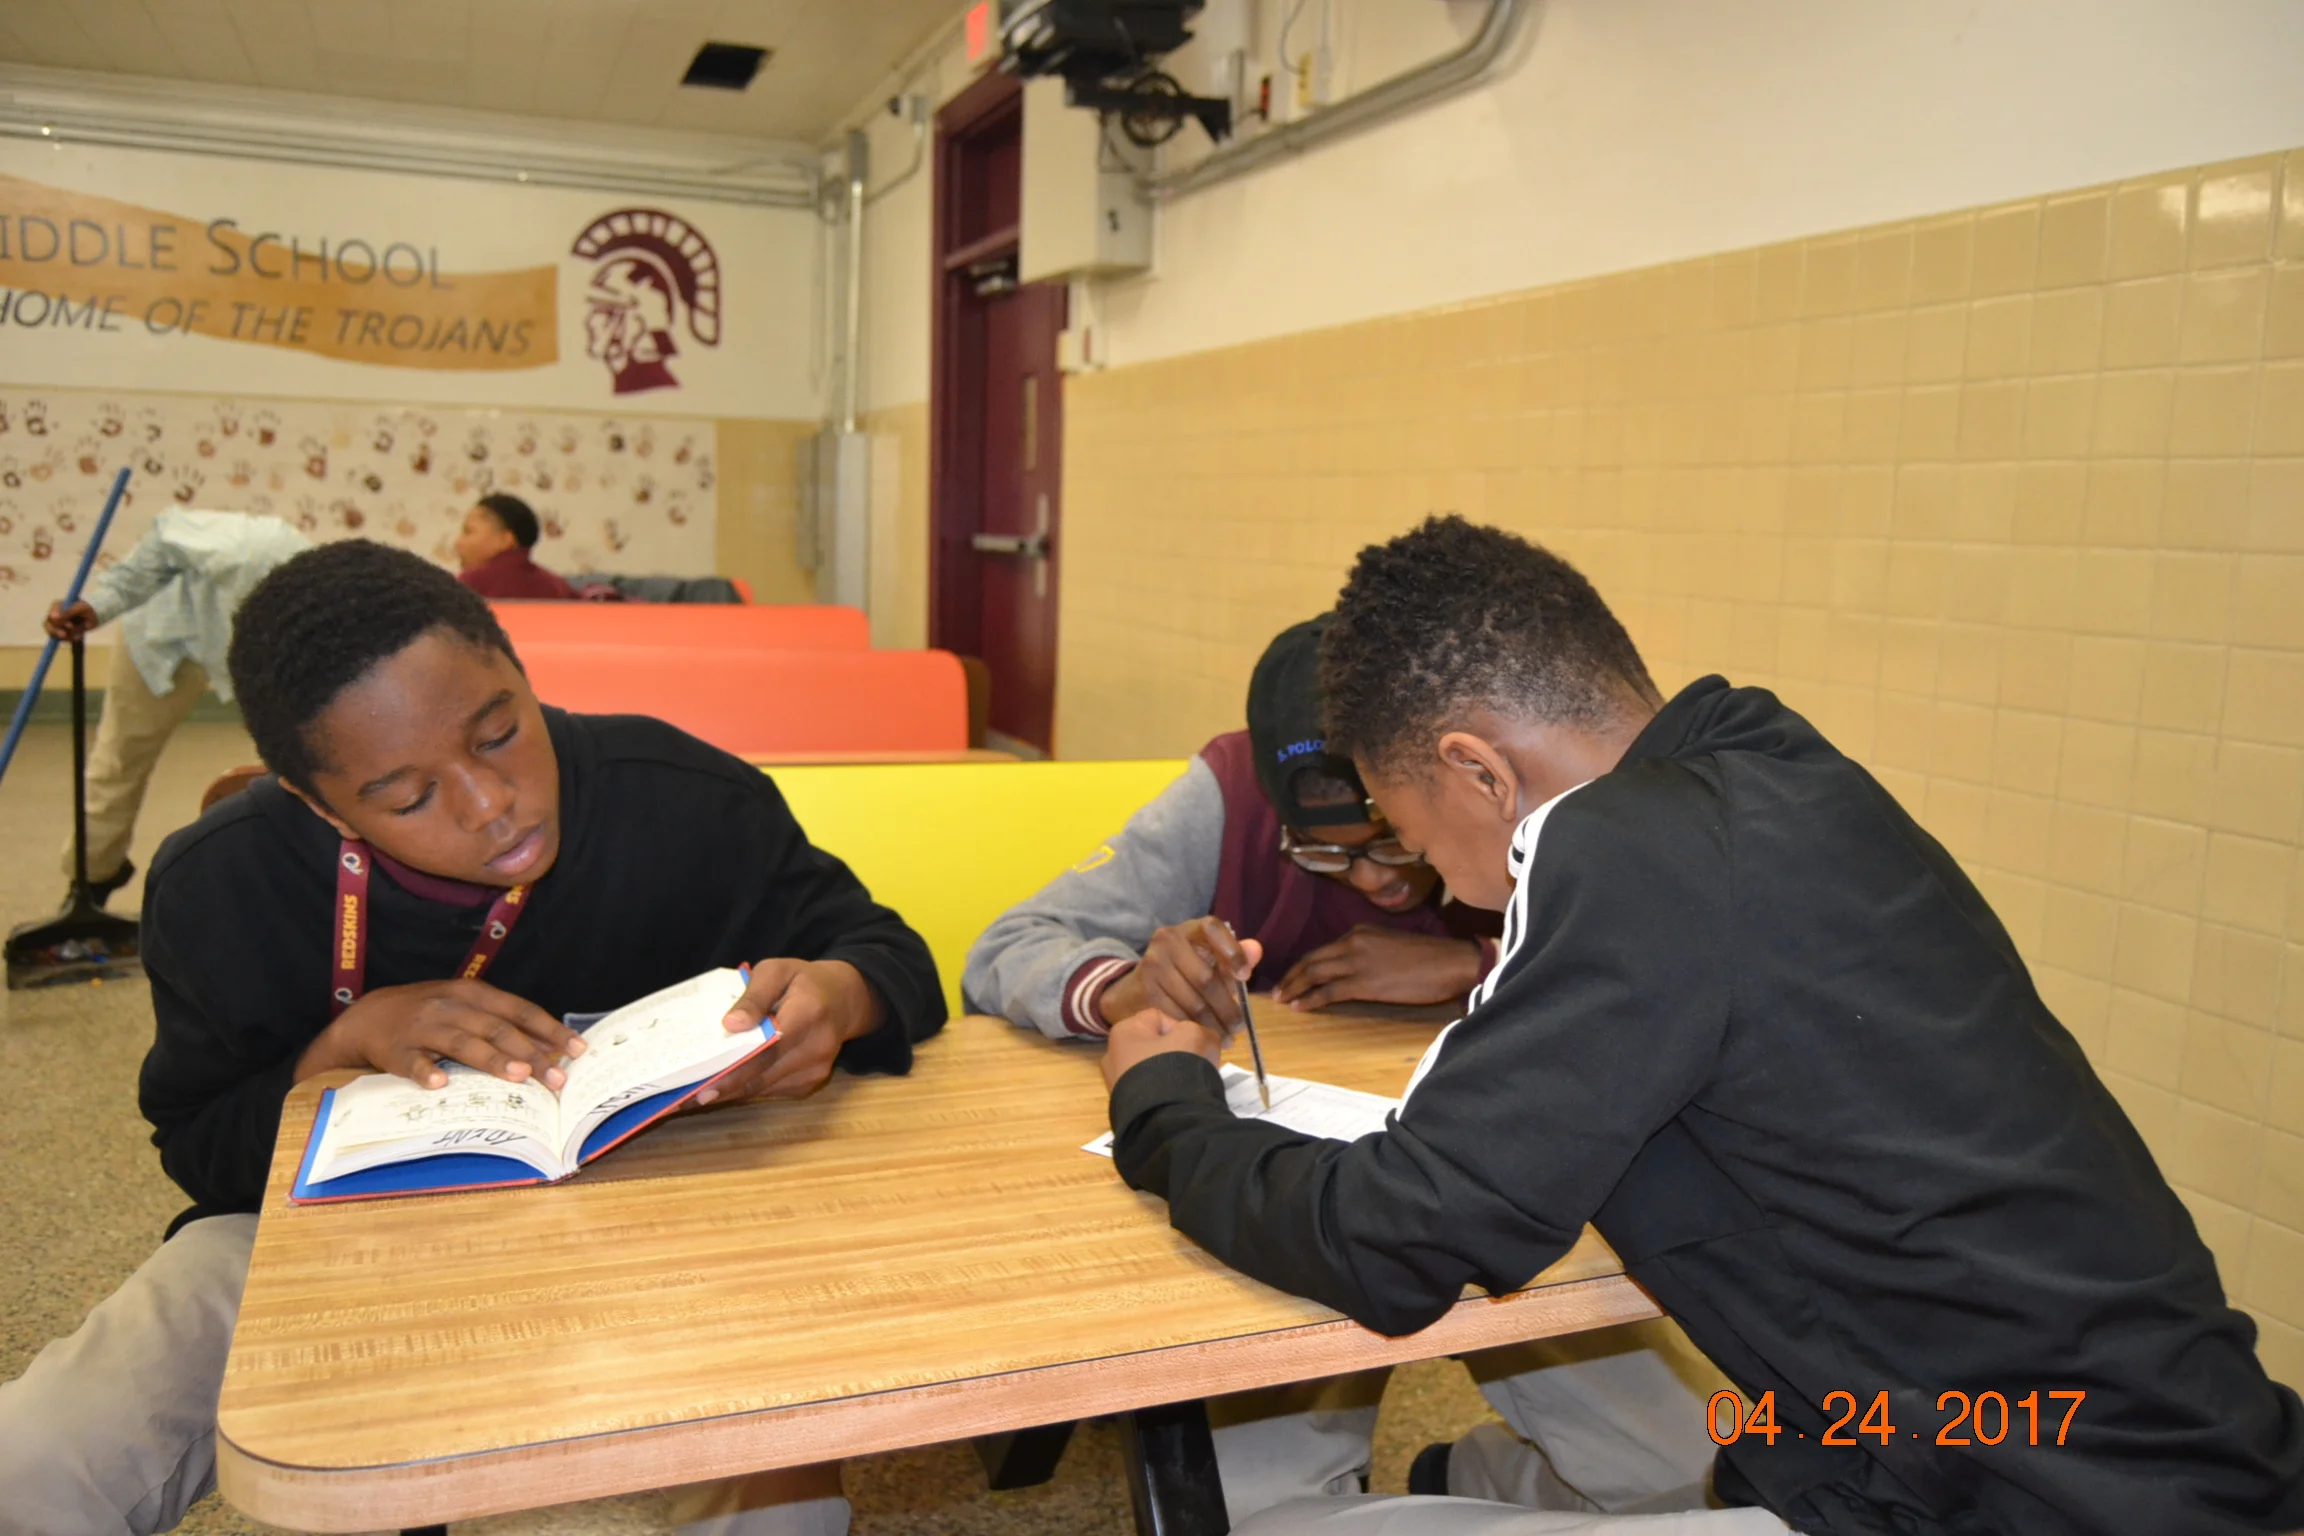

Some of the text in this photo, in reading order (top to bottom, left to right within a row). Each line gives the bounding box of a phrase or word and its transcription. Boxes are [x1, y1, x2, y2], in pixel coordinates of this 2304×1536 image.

[145, 296, 210, 337] OF
[230, 301, 315, 345] THE
[335, 308, 536, 356] TROJANS
[340, 894, 359, 971] REDSKINS
